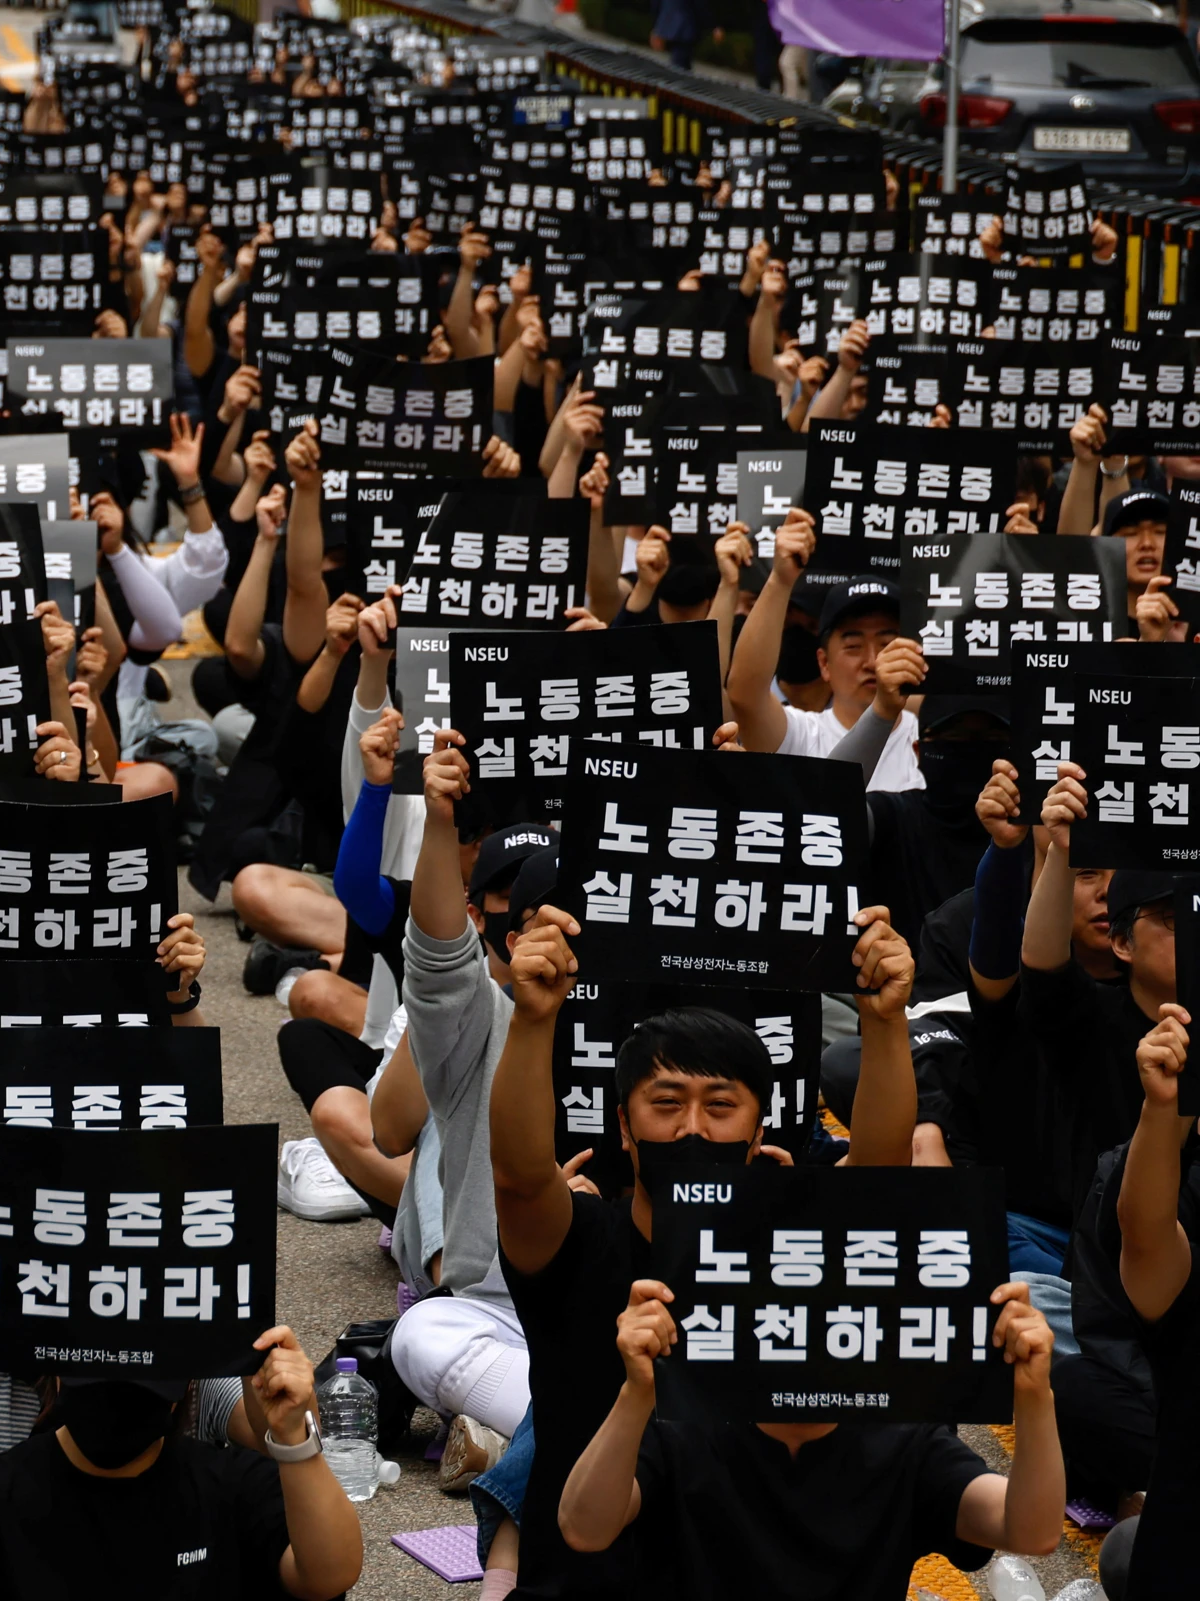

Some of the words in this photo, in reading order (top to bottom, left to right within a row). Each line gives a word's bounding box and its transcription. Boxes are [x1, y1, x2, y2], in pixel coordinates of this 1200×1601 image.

[865, 261, 885, 271] NSEU
[871, 277, 976, 306] 노동존중
[1000, 288, 1105, 314] 노동존중
[594, 306, 621, 317] NSEU
[262, 312, 380, 338] 노동존중
[864, 308, 982, 338] 실천하라!
[16, 347, 43, 355] NSEU
[601, 327, 725, 358] 노동존중
[957, 343, 984, 355] NSEU
[1112, 338, 1140, 351] NSEU
[267, 352, 291, 364] NSEU
[332, 349, 353, 366] NSEU
[876, 358, 901, 368] NSEU
[28, 365, 151, 391] 노동존중
[636, 370, 662, 380] NSEU
[964, 365, 1092, 395] 노동존중
[330, 376, 473, 418] 노동존중
[613, 405, 642, 416] NSEU
[320, 414, 481, 451] 실천하라!
[821, 429, 855, 442] NSEU
[668, 439, 698, 450] NSEU
[749, 461, 781, 471] NSEU
[831, 457, 992, 501] 노동존중
[358, 489, 393, 501] NSEU
[418, 504, 441, 517] NSEU
[821, 501, 998, 539] 실천하라!
[413, 532, 569, 573] 노동존중
[913, 545, 950, 557] NSEU
[402, 577, 574, 619] 실천하라!
[849, 583, 888, 596] NSEU
[928, 572, 1101, 609] 노동존중
[411, 640, 449, 651] NSEU
[919, 620, 1112, 656] 실천하라!
[465, 648, 508, 661] NSEU
[1027, 654, 1068, 667] NSEU
[484, 671, 690, 721] 노동존중
[1090, 689, 1131, 704] NSEU
[474, 727, 704, 778] 실천!
[1105, 725, 1200, 768] 노동
[585, 758, 637, 778] NSEU
[1094, 781, 1188, 825] 실천
[505, 833, 549, 848] NSEU
[599, 802, 842, 866] 노동존중
[582, 871, 861, 935] 실천하라!
[661, 956, 769, 973] 전국삼성전자노동조합
[567, 985, 598, 999] SEU
[674, 1184, 731, 1202] NSEU
[696, 1230, 971, 1287] 노동존중
[681, 1305, 987, 1361] 실천하라!
[35, 1347, 153, 1364] 전국삼성전자노동조합
[772, 1393, 889, 1407] 전국삼성전자노동조합
